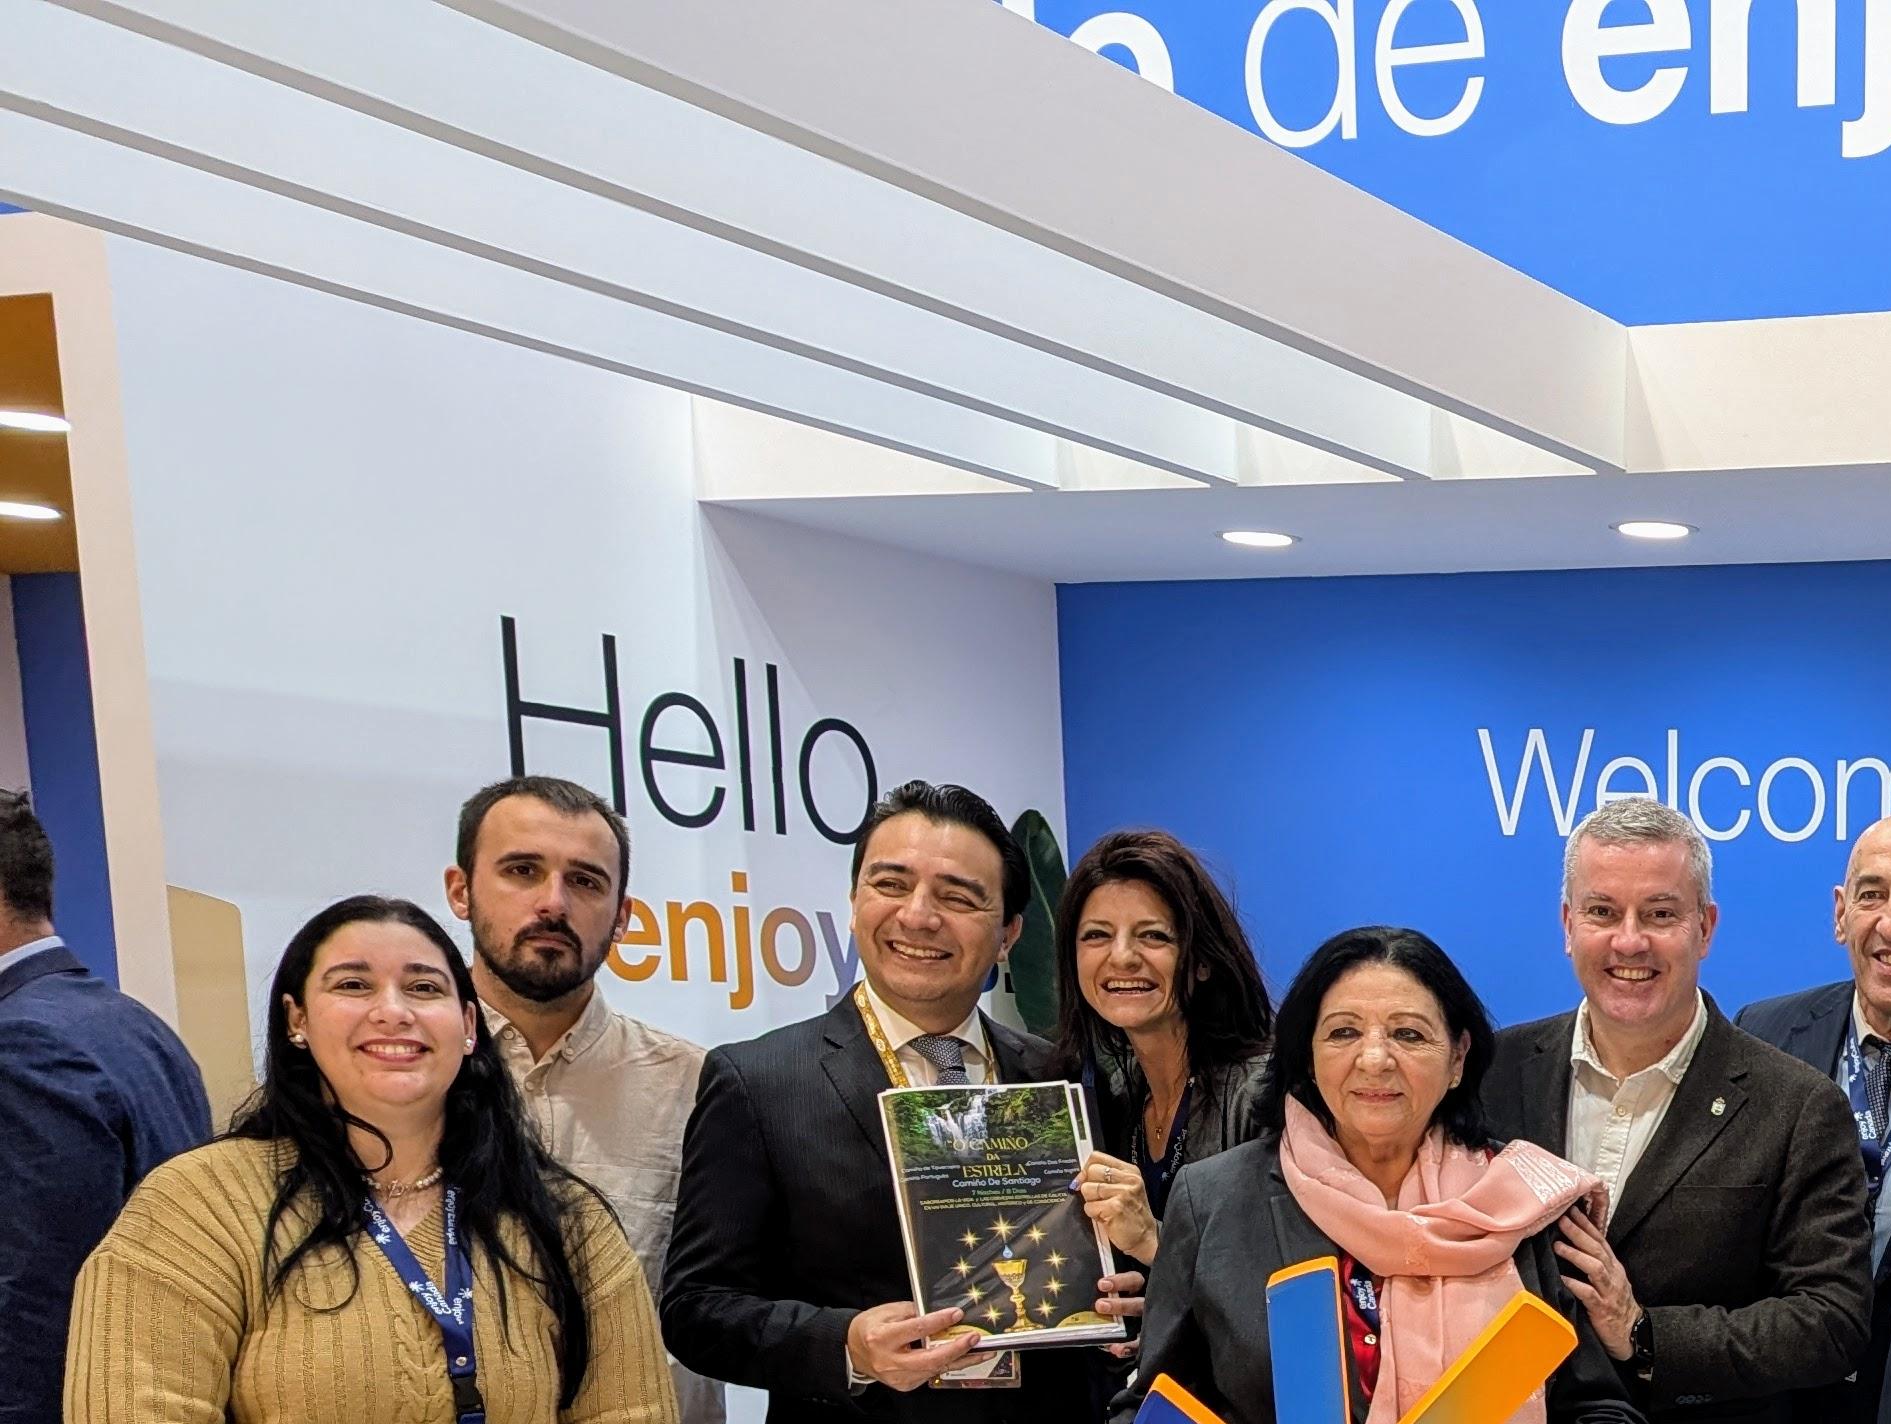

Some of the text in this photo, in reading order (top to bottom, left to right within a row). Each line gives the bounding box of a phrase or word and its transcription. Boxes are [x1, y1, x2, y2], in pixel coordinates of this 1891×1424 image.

[1245, 0, 1486, 148] de
[501, 615, 878, 845] Hello
[605, 870, 863, 1012] enjoy
[962, 1163, 1028, 1178] ESTRELA
[1002, 1176, 1042, 1187] Santiago
